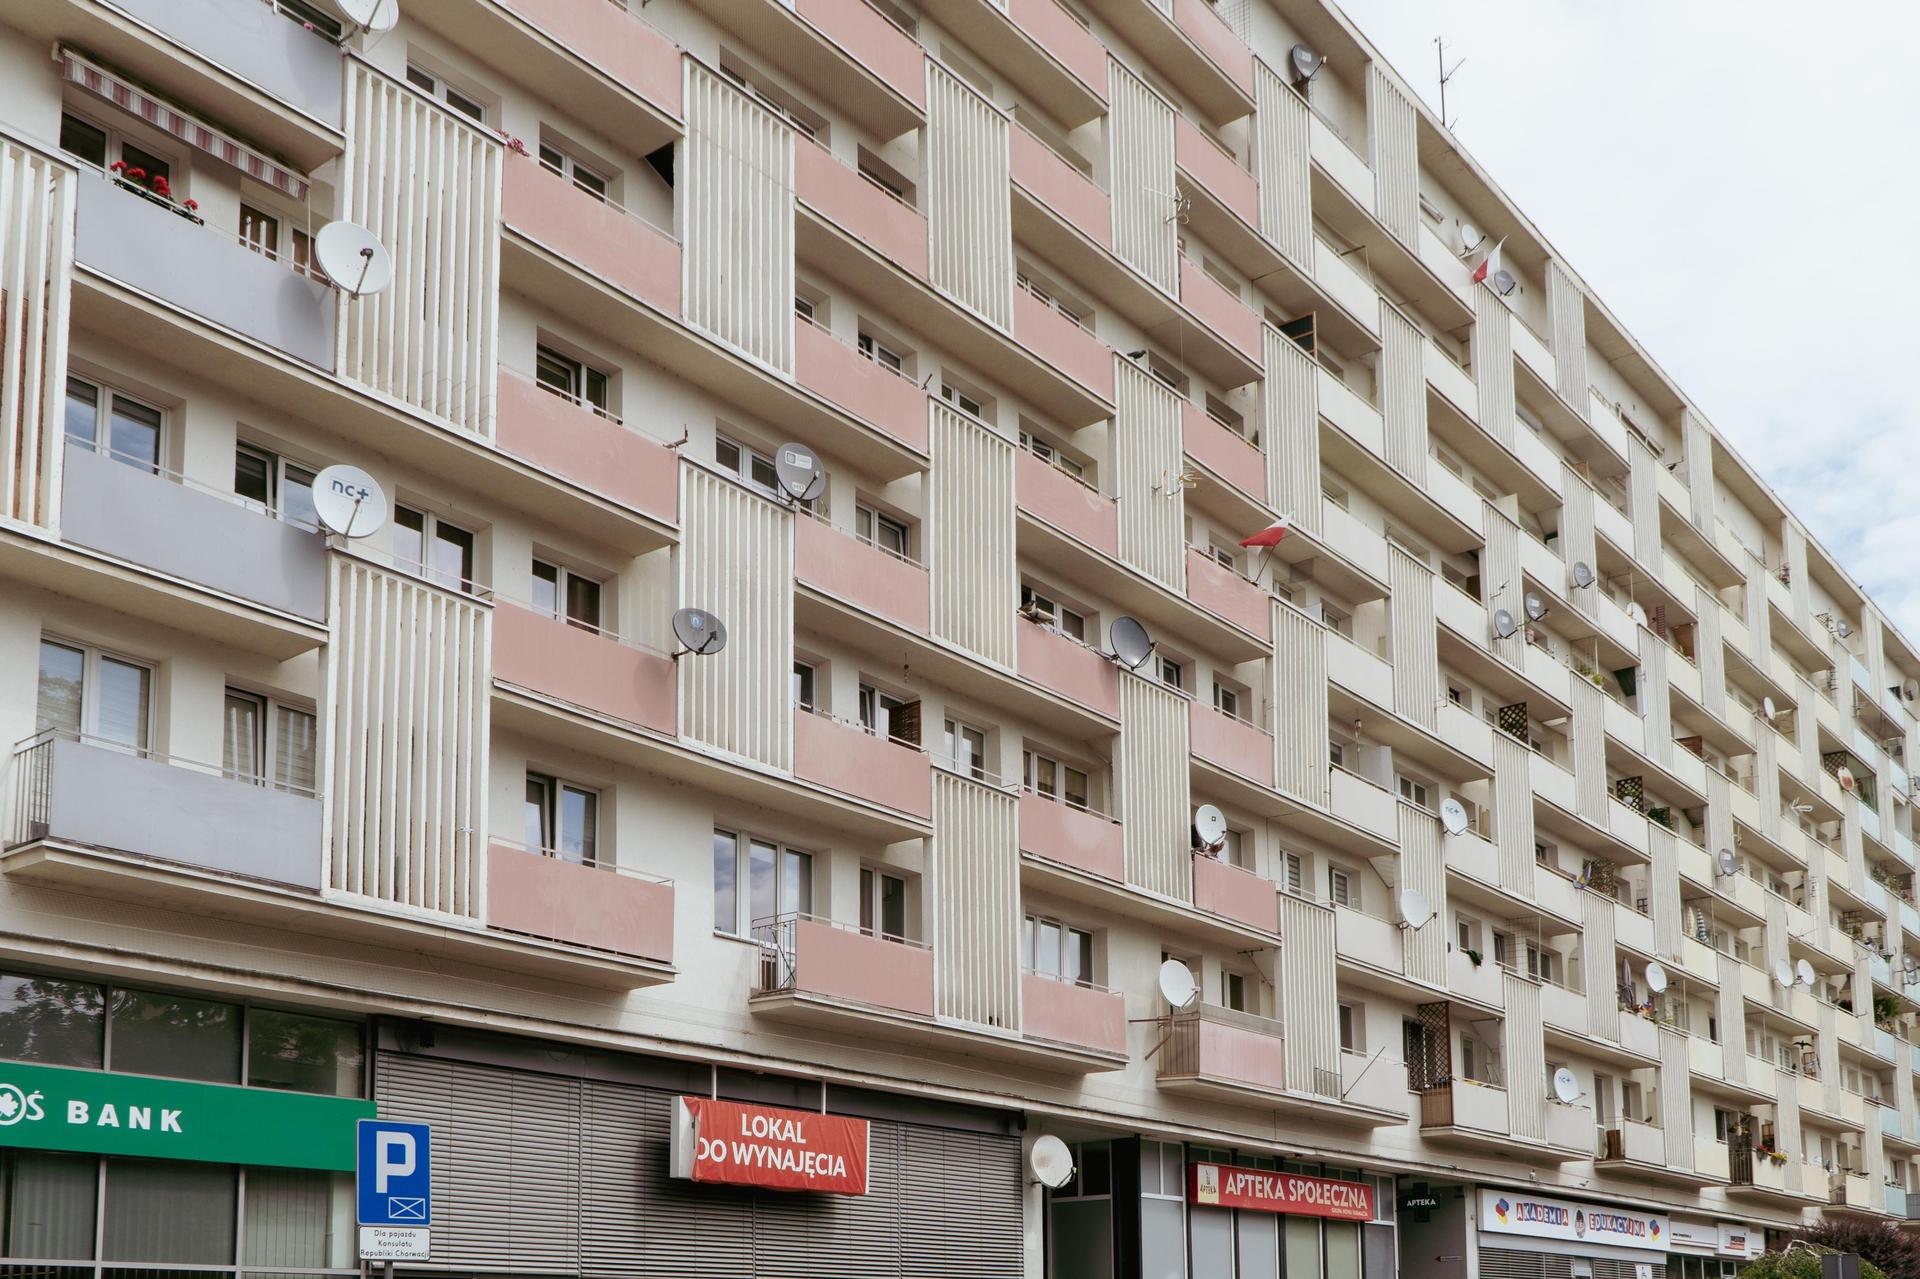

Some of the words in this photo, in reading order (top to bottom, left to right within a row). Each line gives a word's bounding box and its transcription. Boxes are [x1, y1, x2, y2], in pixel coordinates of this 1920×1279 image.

[332, 480, 369, 499] nc+
[67, 1100, 183, 1133] BANK
[741, 1113, 807, 1144] LOKAL
[376, 1131, 416, 1193] P
[732, 1141, 847, 1178] WYNAJĘCIA
[1225, 1172, 1285, 1201] APTEKA
[1289, 1179, 1368, 1210] SPOŁECZNA
[1407, 1199, 1436, 1207] APTEKA
[1516, 1203, 1569, 1226] AKADEMIA
[1589, 1213, 1646, 1237] EDUKACYJNA
[360, 1249, 393, 1257] Republiki
